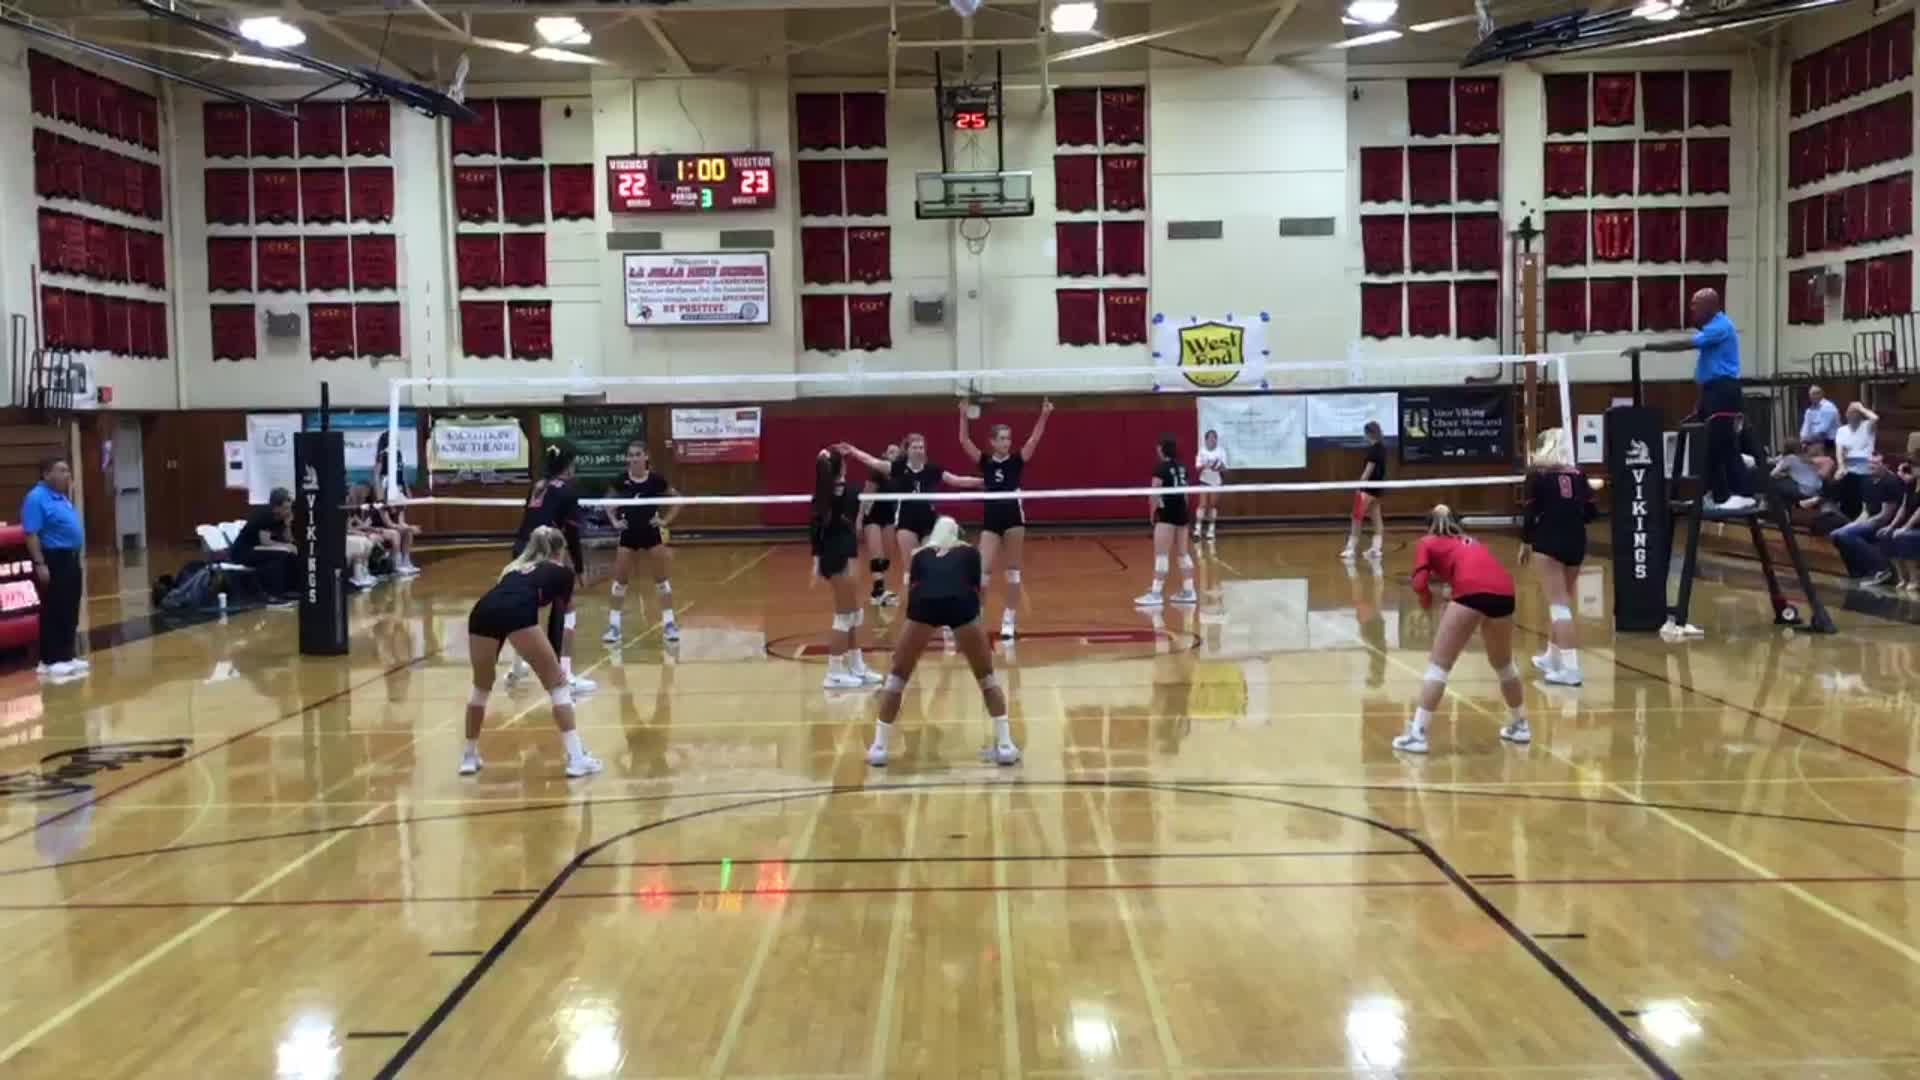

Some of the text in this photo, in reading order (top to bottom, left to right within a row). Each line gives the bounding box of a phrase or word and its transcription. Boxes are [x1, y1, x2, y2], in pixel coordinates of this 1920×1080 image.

[956, 113, 985, 129] 25
[609, 160, 648, 170] VIKINGS
[677, 158, 726, 182] 1:00
[732, 157, 771, 167] VISITOR
[618, 173, 647, 197] 22
[741, 169, 769, 193] 23
[701, 188, 713, 208] 3
[1184, 331, 1237, 355] West
[1194, 349, 1233, 366] End
[1456, 407, 1485, 418] Viking
[1631, 468, 1648, 579] VIKINGS
[306, 494, 317, 603] VIKINGS
